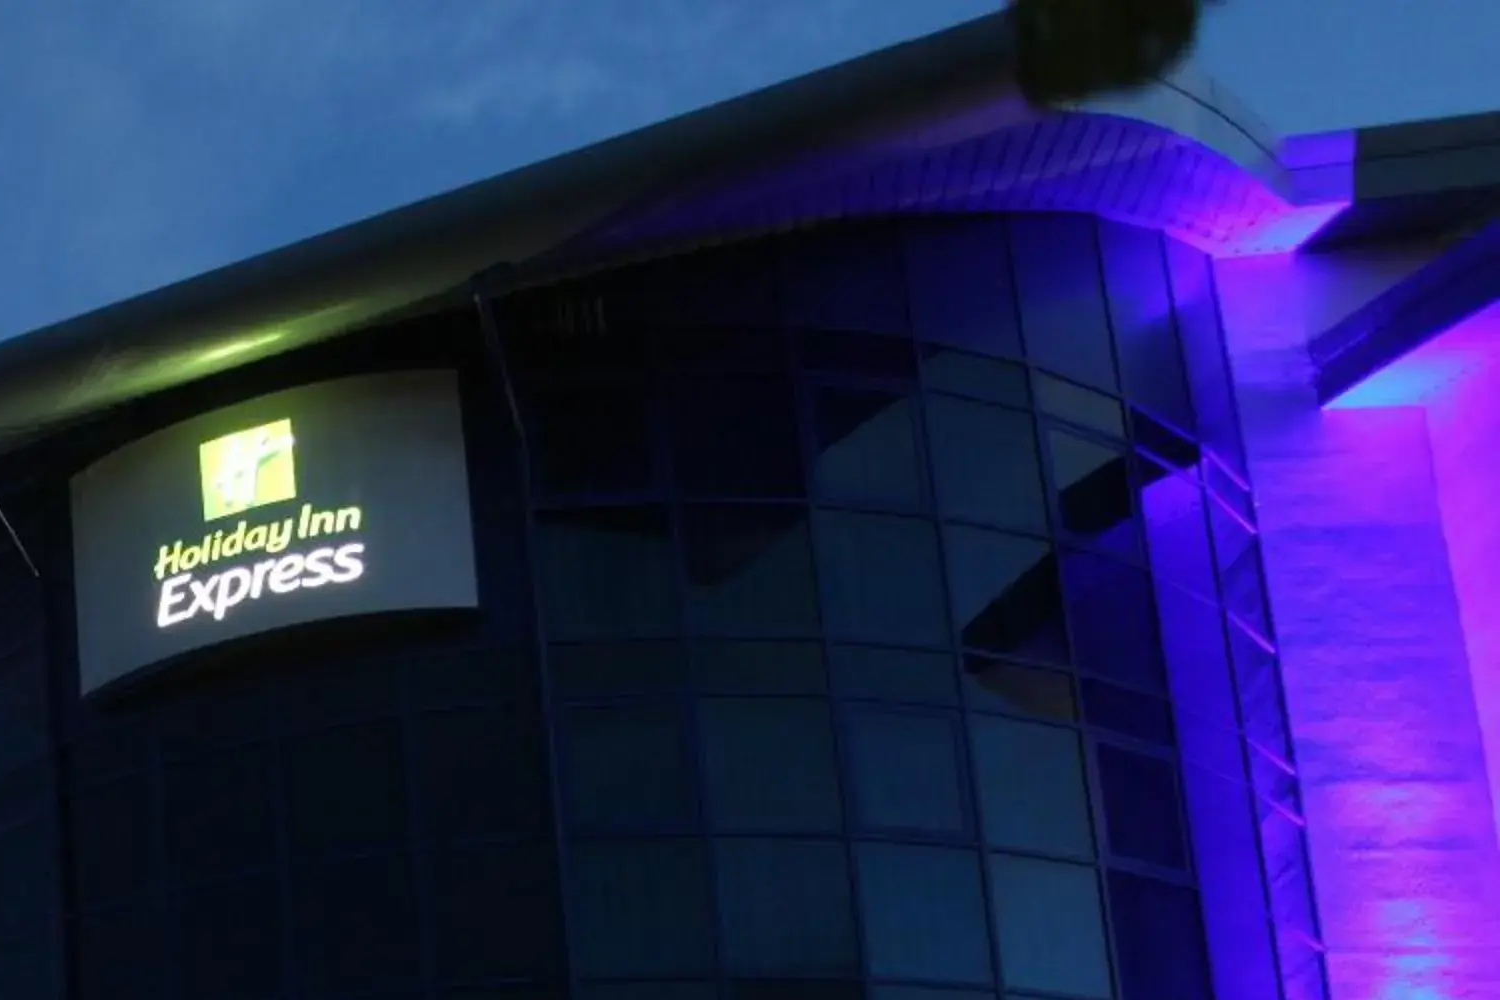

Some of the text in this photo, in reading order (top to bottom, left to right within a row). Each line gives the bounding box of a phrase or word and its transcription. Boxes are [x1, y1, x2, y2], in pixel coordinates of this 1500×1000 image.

[154, 504, 361, 580] Holiday Inn
[156, 542, 365, 627] Express
